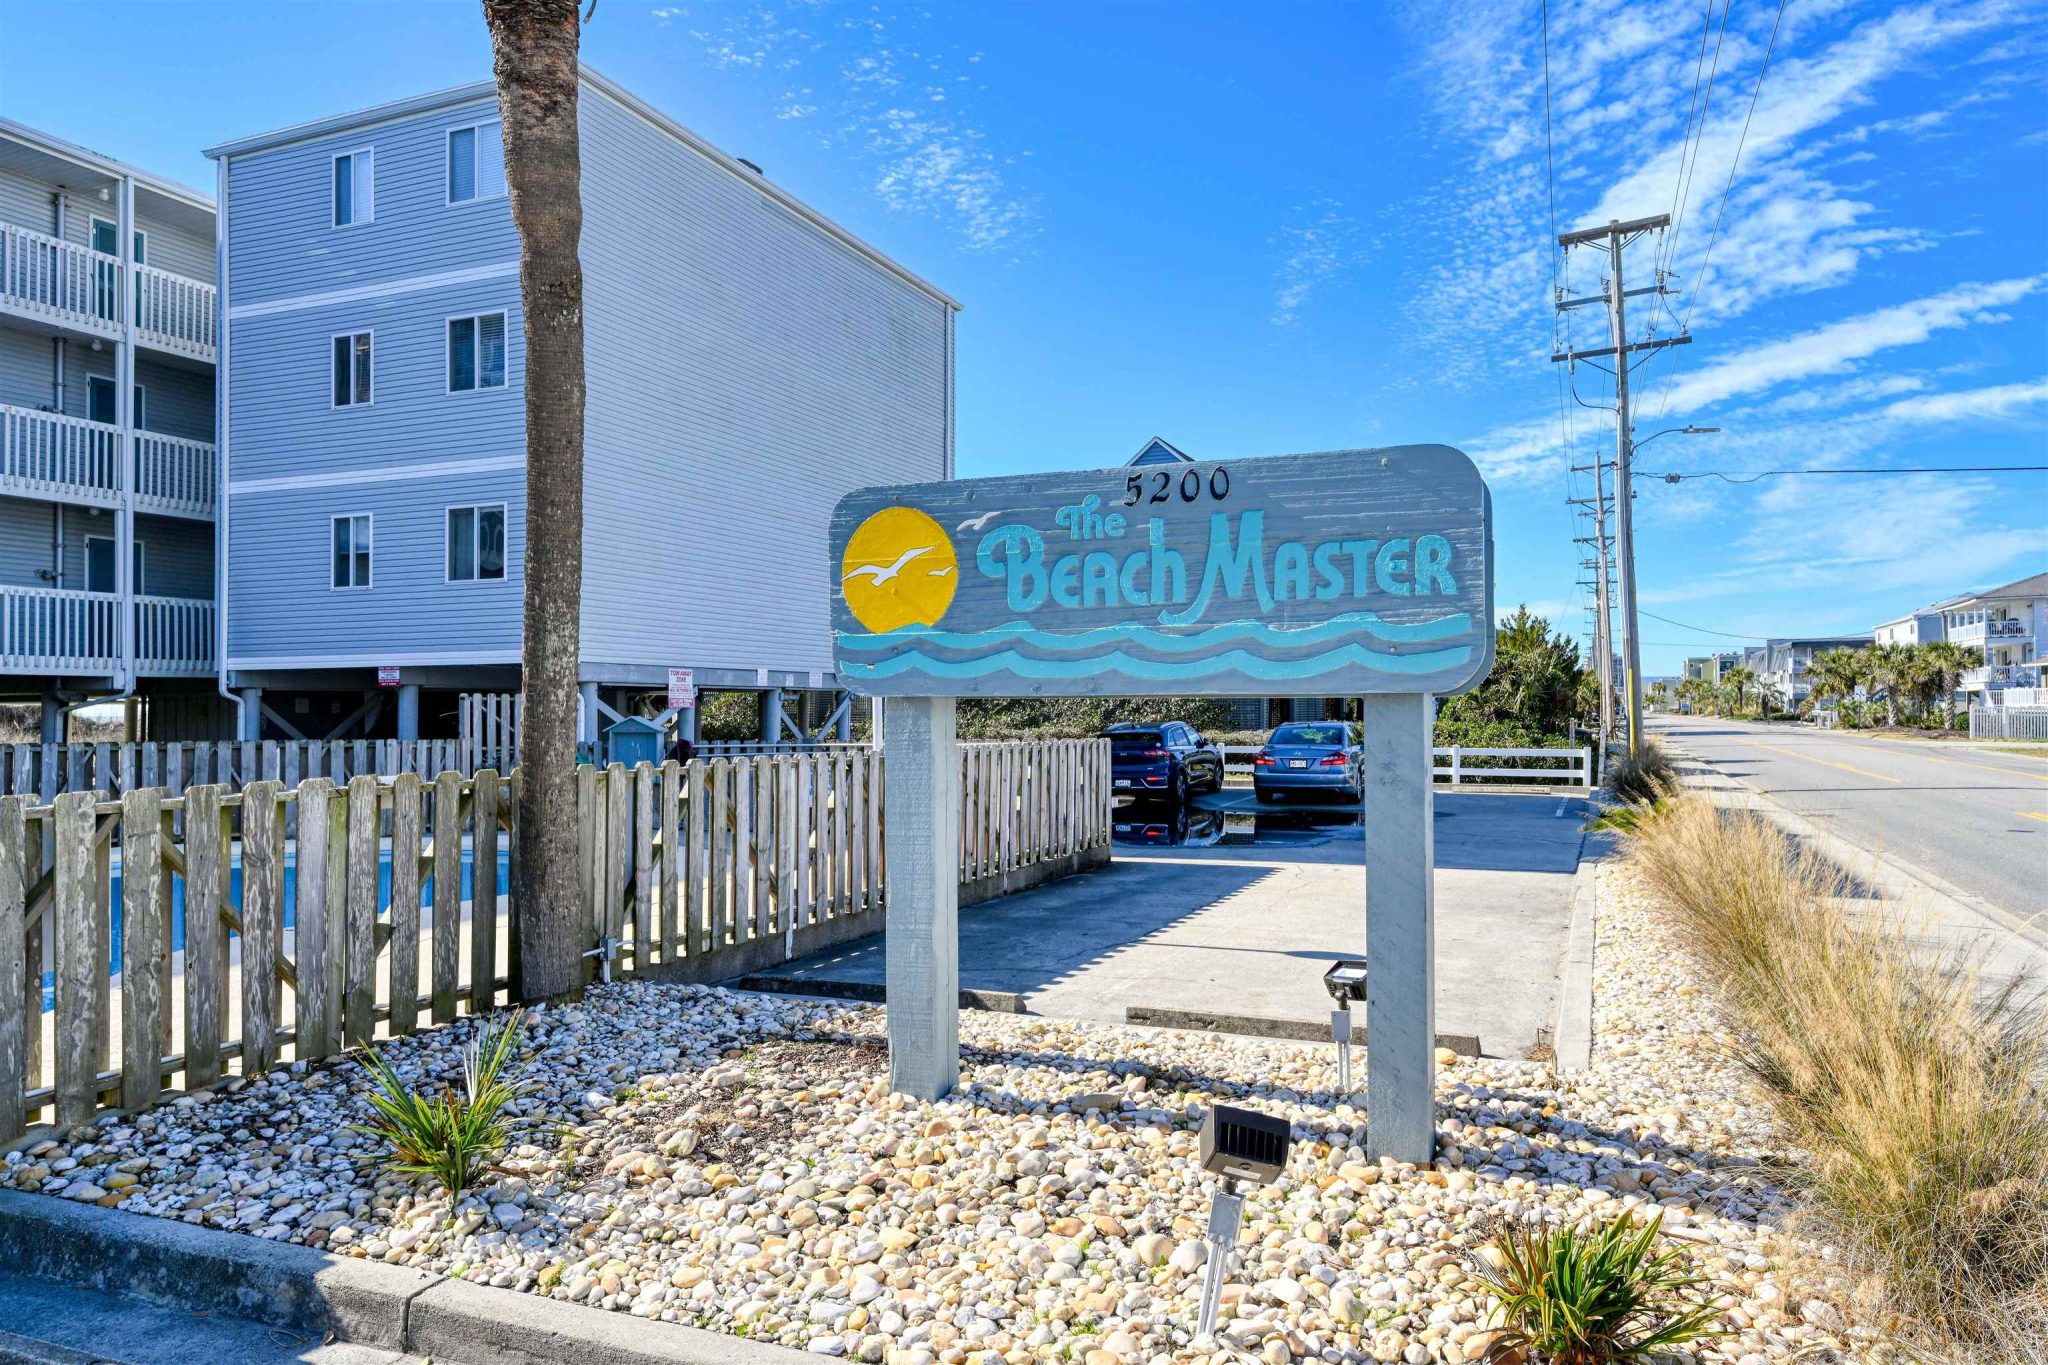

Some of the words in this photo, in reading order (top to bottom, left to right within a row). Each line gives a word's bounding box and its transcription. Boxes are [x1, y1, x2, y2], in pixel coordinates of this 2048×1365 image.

[1123, 466, 1230, 507] 5200
[1055, 493, 1127, 540] The
[1157, 509, 1459, 626] MASTER
